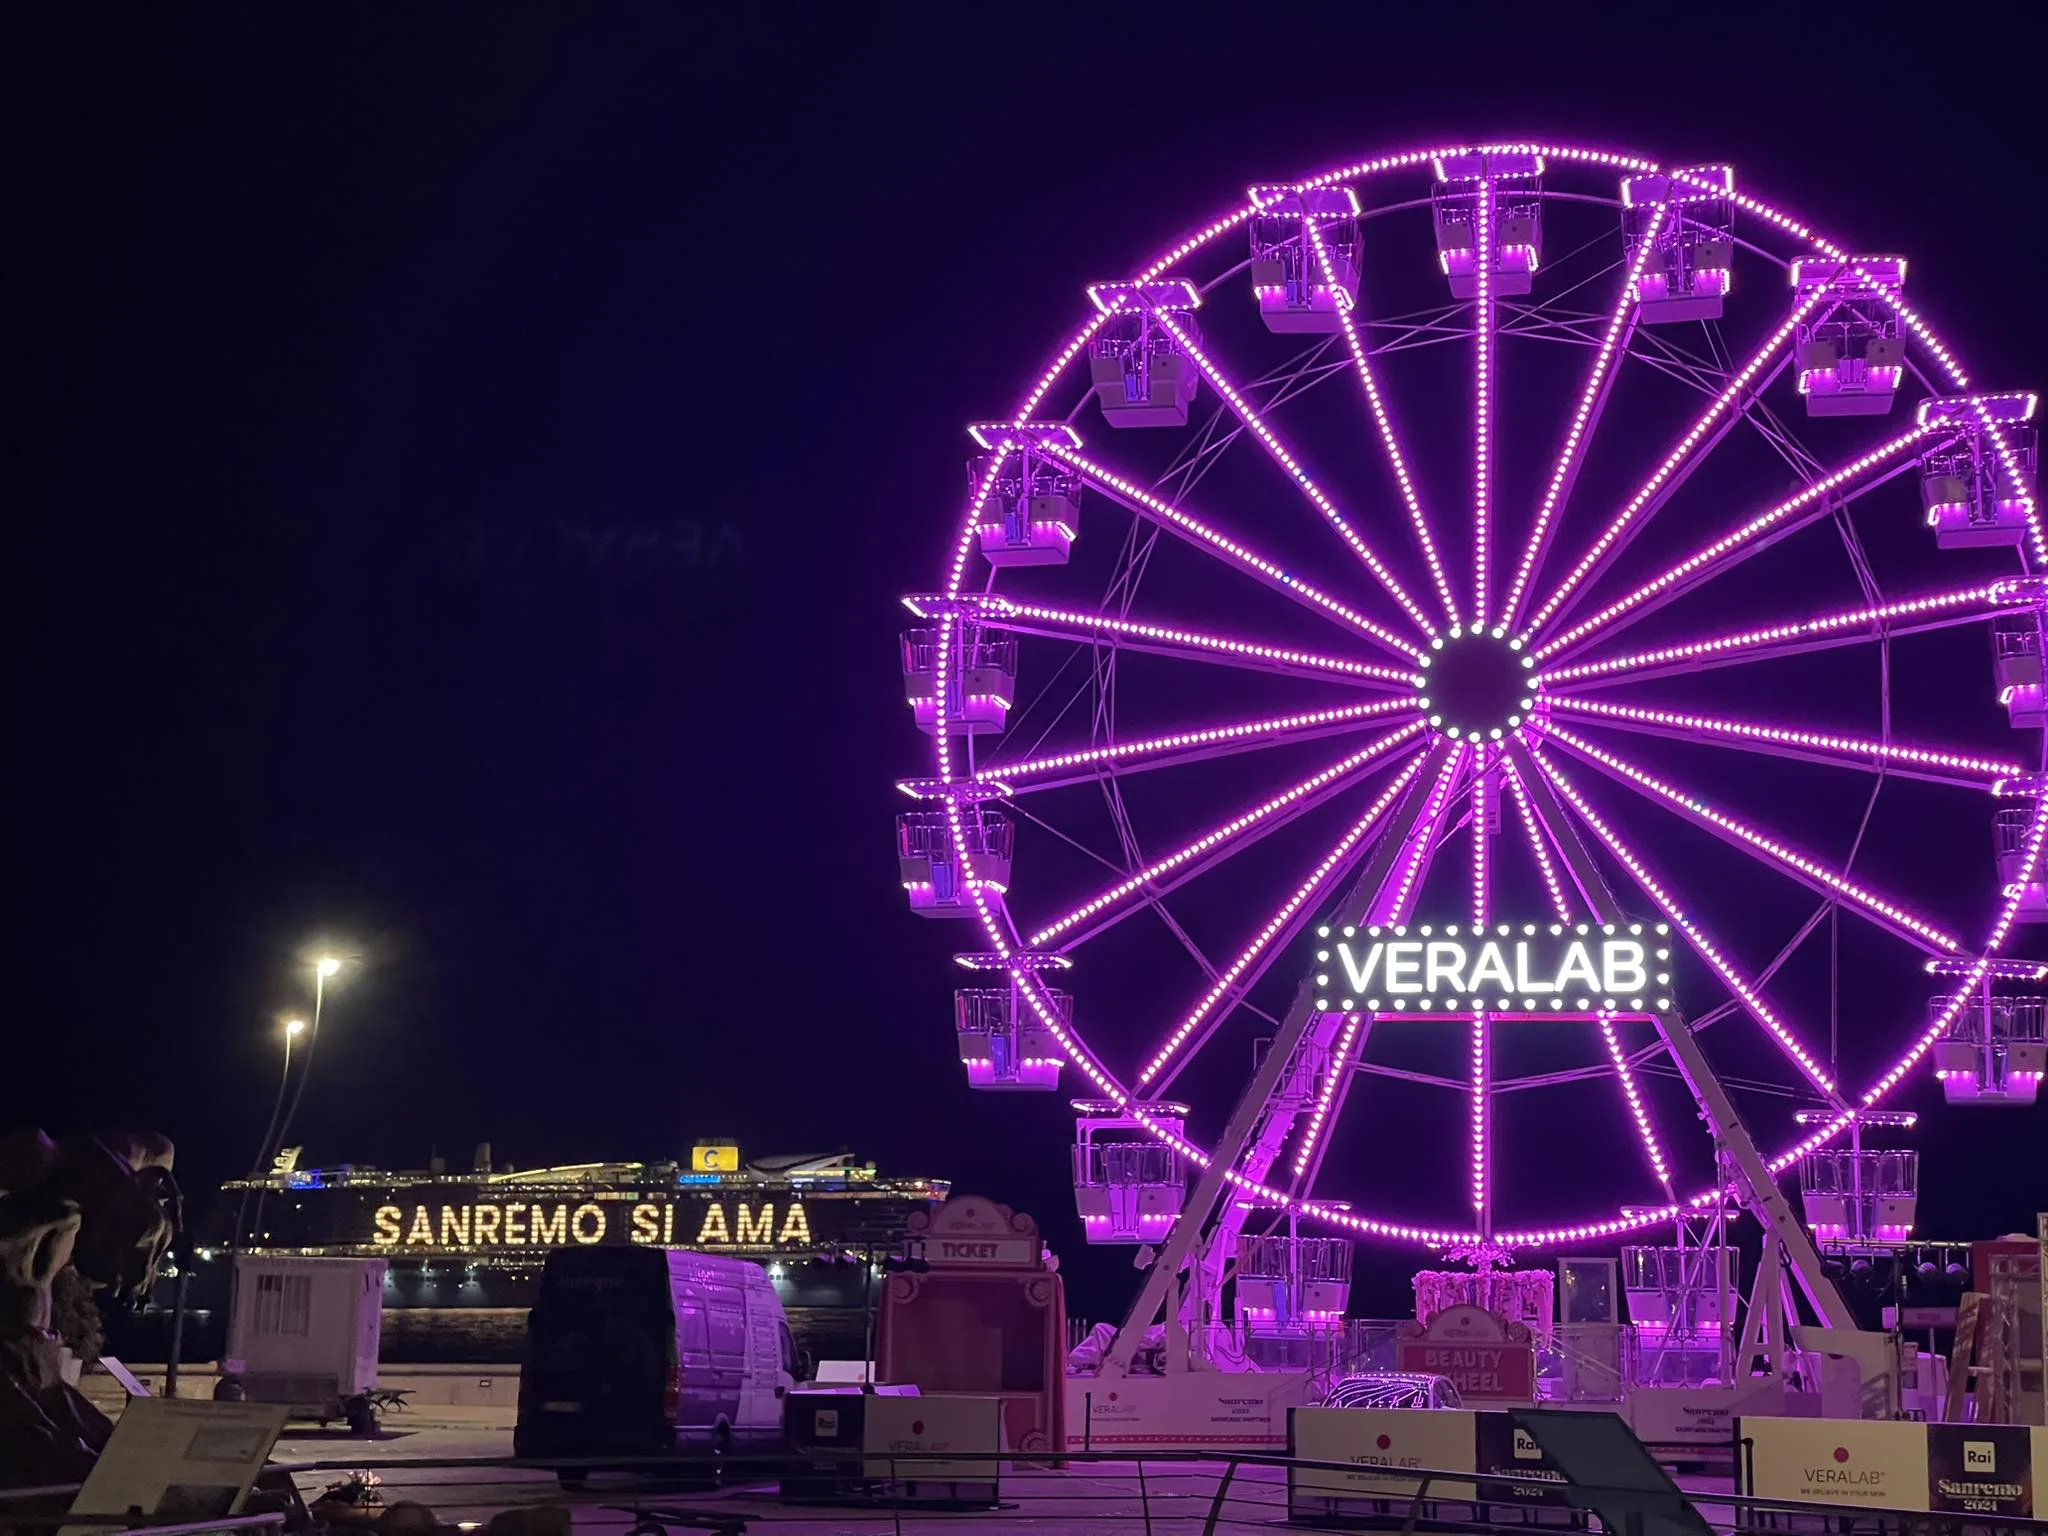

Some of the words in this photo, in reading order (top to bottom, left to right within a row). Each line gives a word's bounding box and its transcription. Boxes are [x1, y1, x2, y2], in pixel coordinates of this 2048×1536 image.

[1337, 941, 1647, 993] VERALAB
[704, 1149, 718, 1168] C
[373, 1204, 606, 1245] SANREMO
[631, 1203, 674, 1243] SI
[696, 1203, 811, 1243] AMA
[942, 1243, 999, 1258] TICKET
[1424, 1348, 1503, 1369] BEAUTY
[1448, 1371, 1504, 1393] HEEL
[1517, 1438, 1538, 1450] Ra
[1968, 1450, 1991, 1463] Rai
[1938, 1479, 2023, 1496] Sanremo
[1963, 1499, 1998, 1511] 2024
